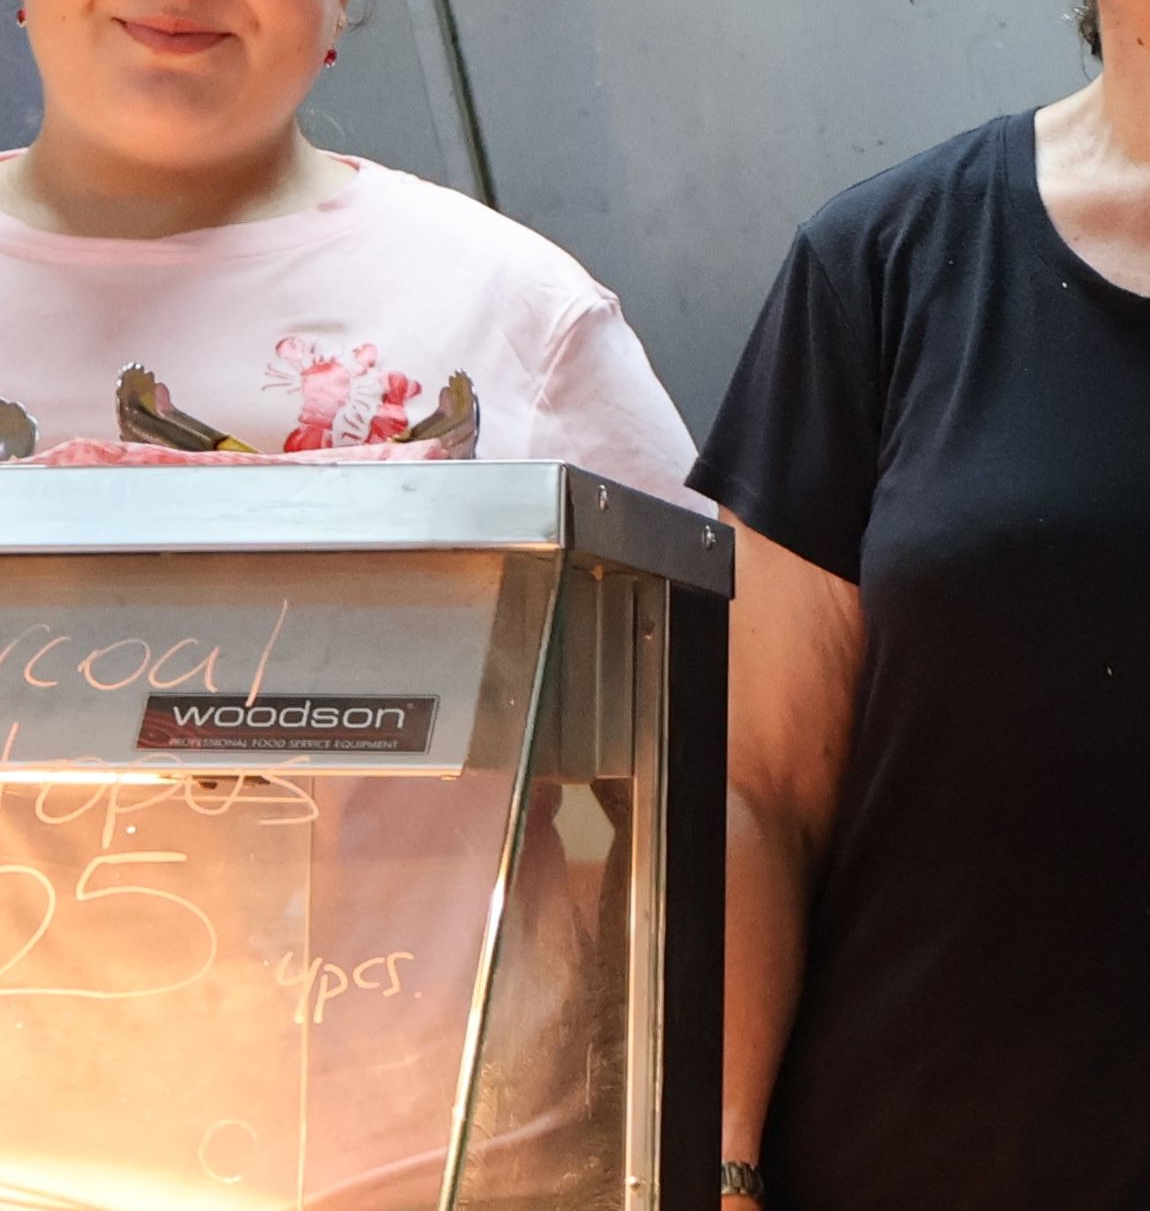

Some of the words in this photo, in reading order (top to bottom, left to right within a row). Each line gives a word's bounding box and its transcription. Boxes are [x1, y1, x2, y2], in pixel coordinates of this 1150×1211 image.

[172, 700, 406, 729] woodson
[168, 737, 248, 749] PROFESSIONAL
[251, 738, 286, 750] FOOD
[288, 739, 331, 750] SERVICE
[333, 739, 399, 750] EQUIPMENT
